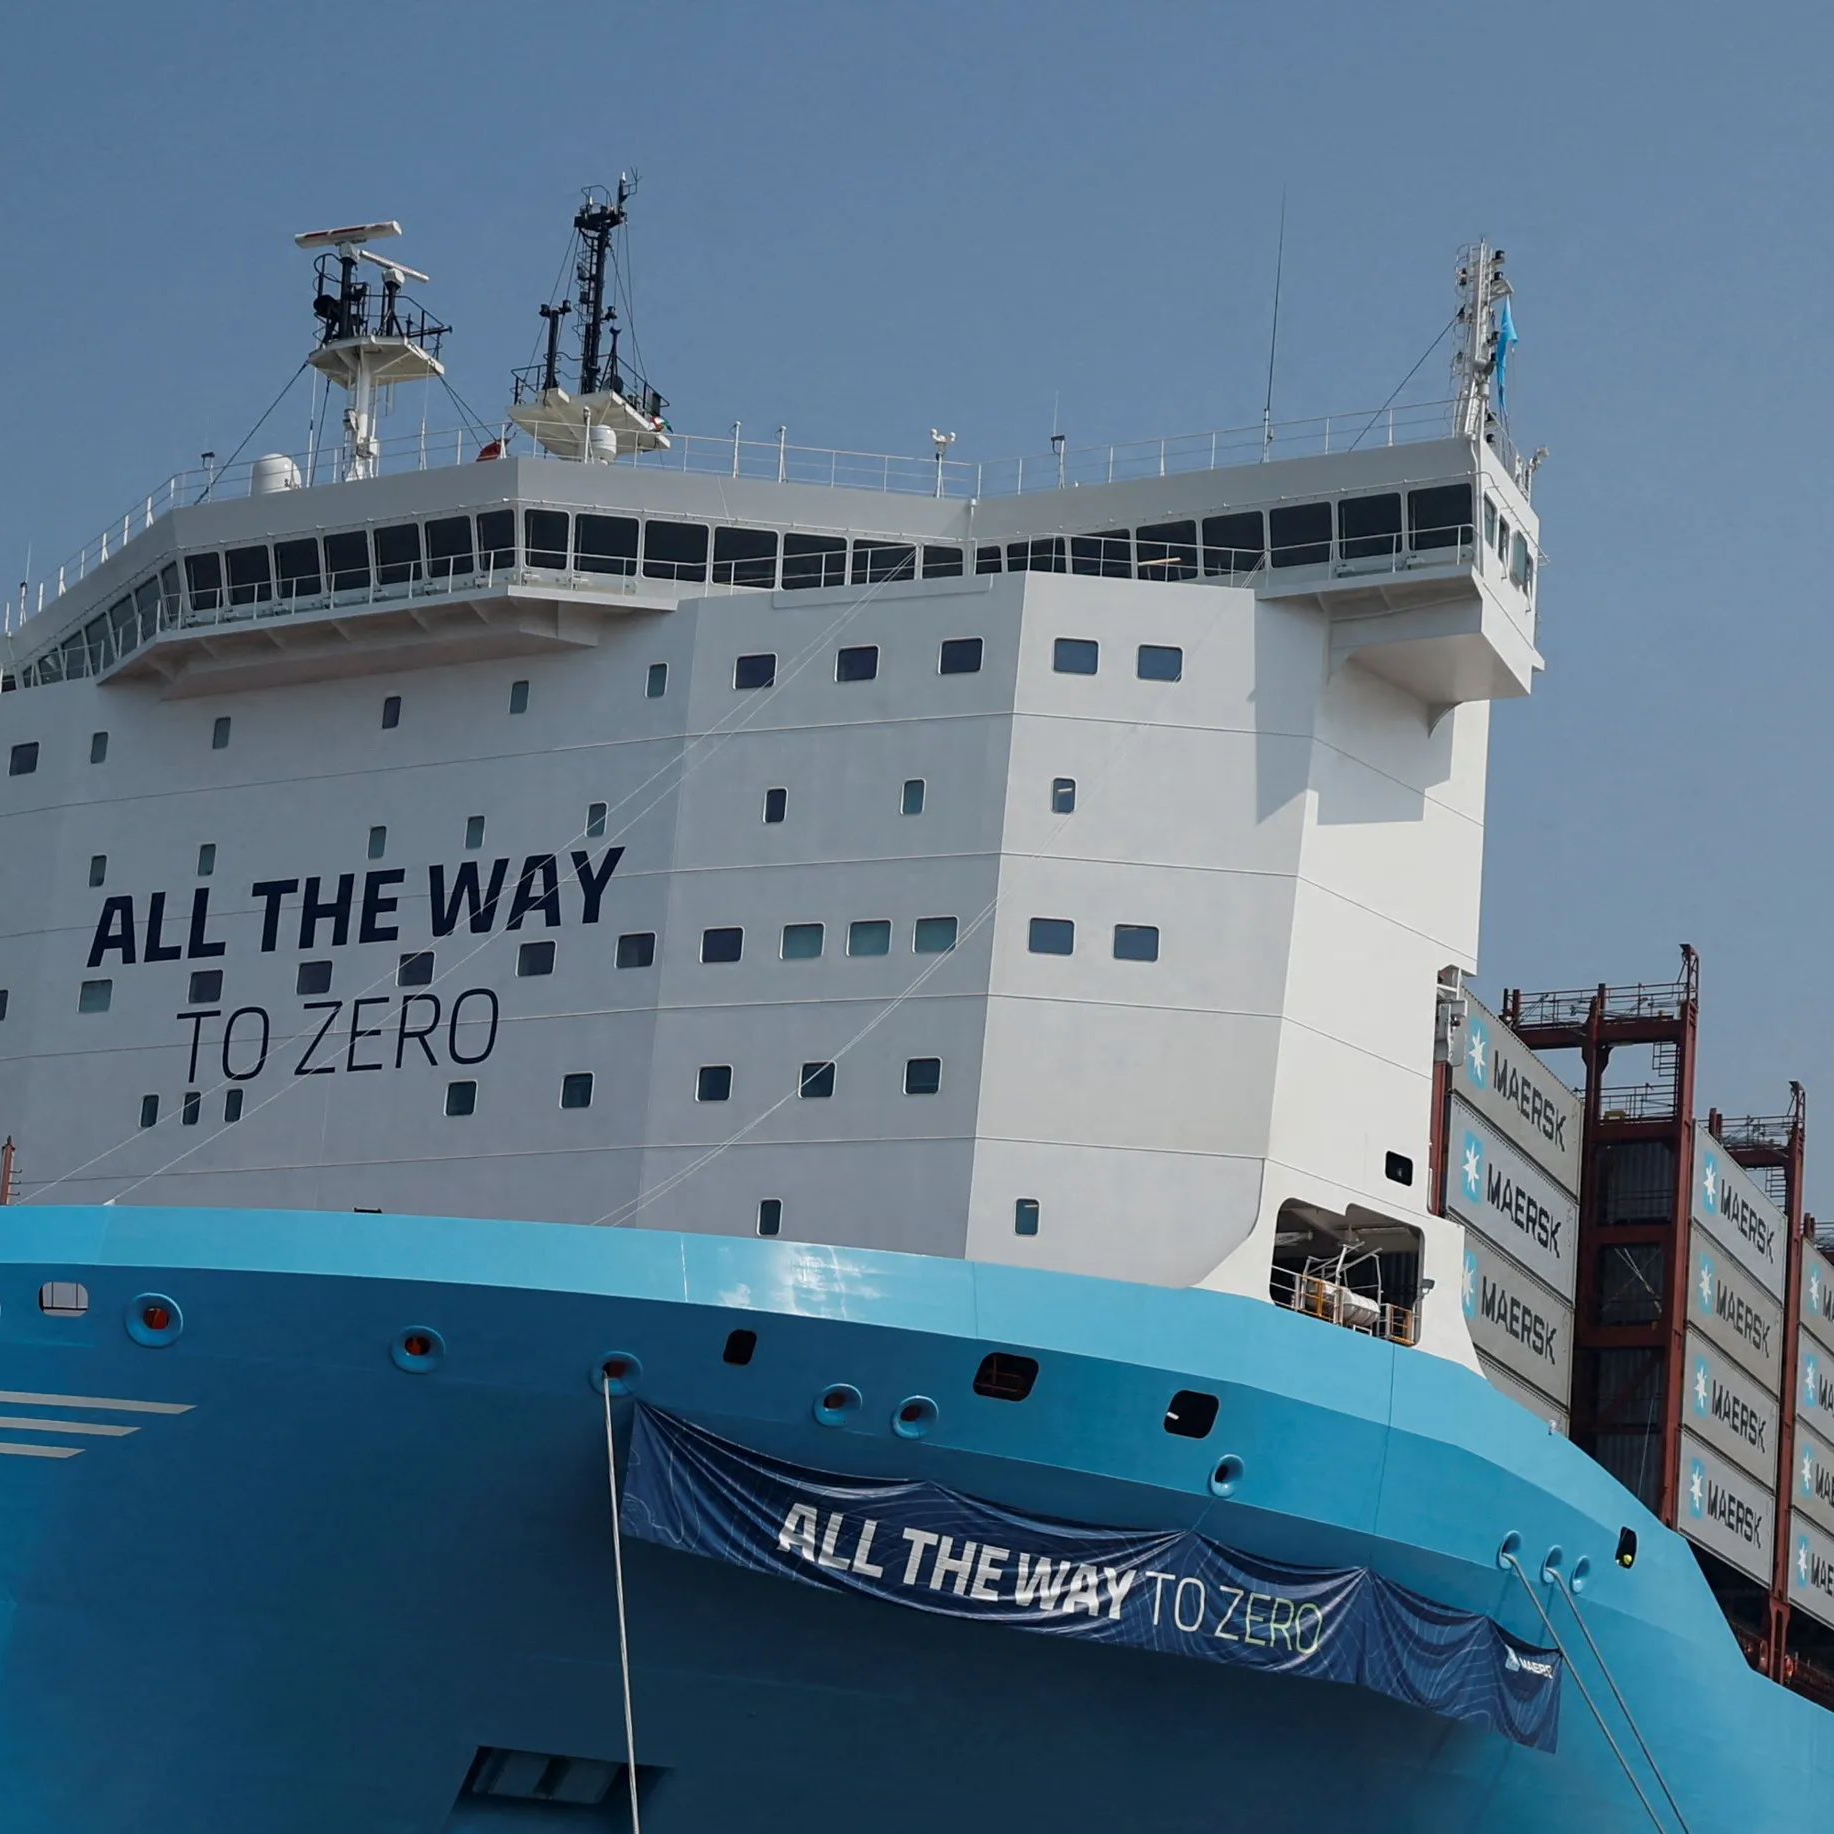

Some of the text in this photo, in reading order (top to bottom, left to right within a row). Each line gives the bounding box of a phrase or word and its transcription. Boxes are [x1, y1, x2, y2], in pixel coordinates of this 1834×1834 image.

[87, 845, 626, 968] ALL THE WAY
[176, 988, 499, 1085] TO ZERO
[1494, 1050, 1566, 1152] MAERSK
[1487, 1163, 1560, 1258] MAERSK
[1720, 1178, 1775, 1264] MAERSK
[1482, 1275, 1556, 1365] MAERSK
[1716, 1279, 1771, 1359] MAERSK
[1711, 1379, 1766, 1454] MAERSK
[1707, 1479, 1762, 1550] MAERSK
[777, 1503, 1322, 1656] ALL THE WAY TO ZERO
